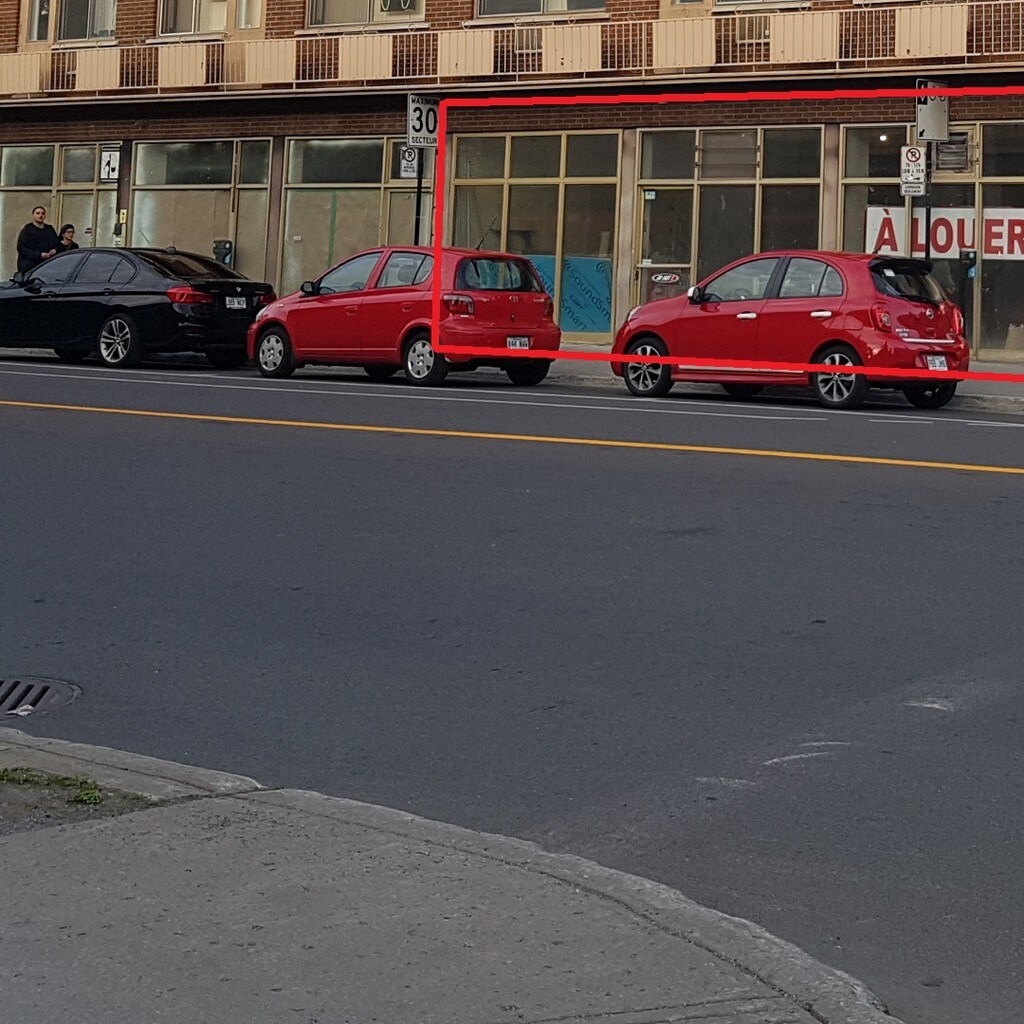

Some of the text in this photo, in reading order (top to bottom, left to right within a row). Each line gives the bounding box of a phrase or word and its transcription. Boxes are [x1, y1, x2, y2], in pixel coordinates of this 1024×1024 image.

[412, 106, 438, 134] 30
[411, 136, 438, 144] SECTEUR
[873, 208, 899, 254] À
